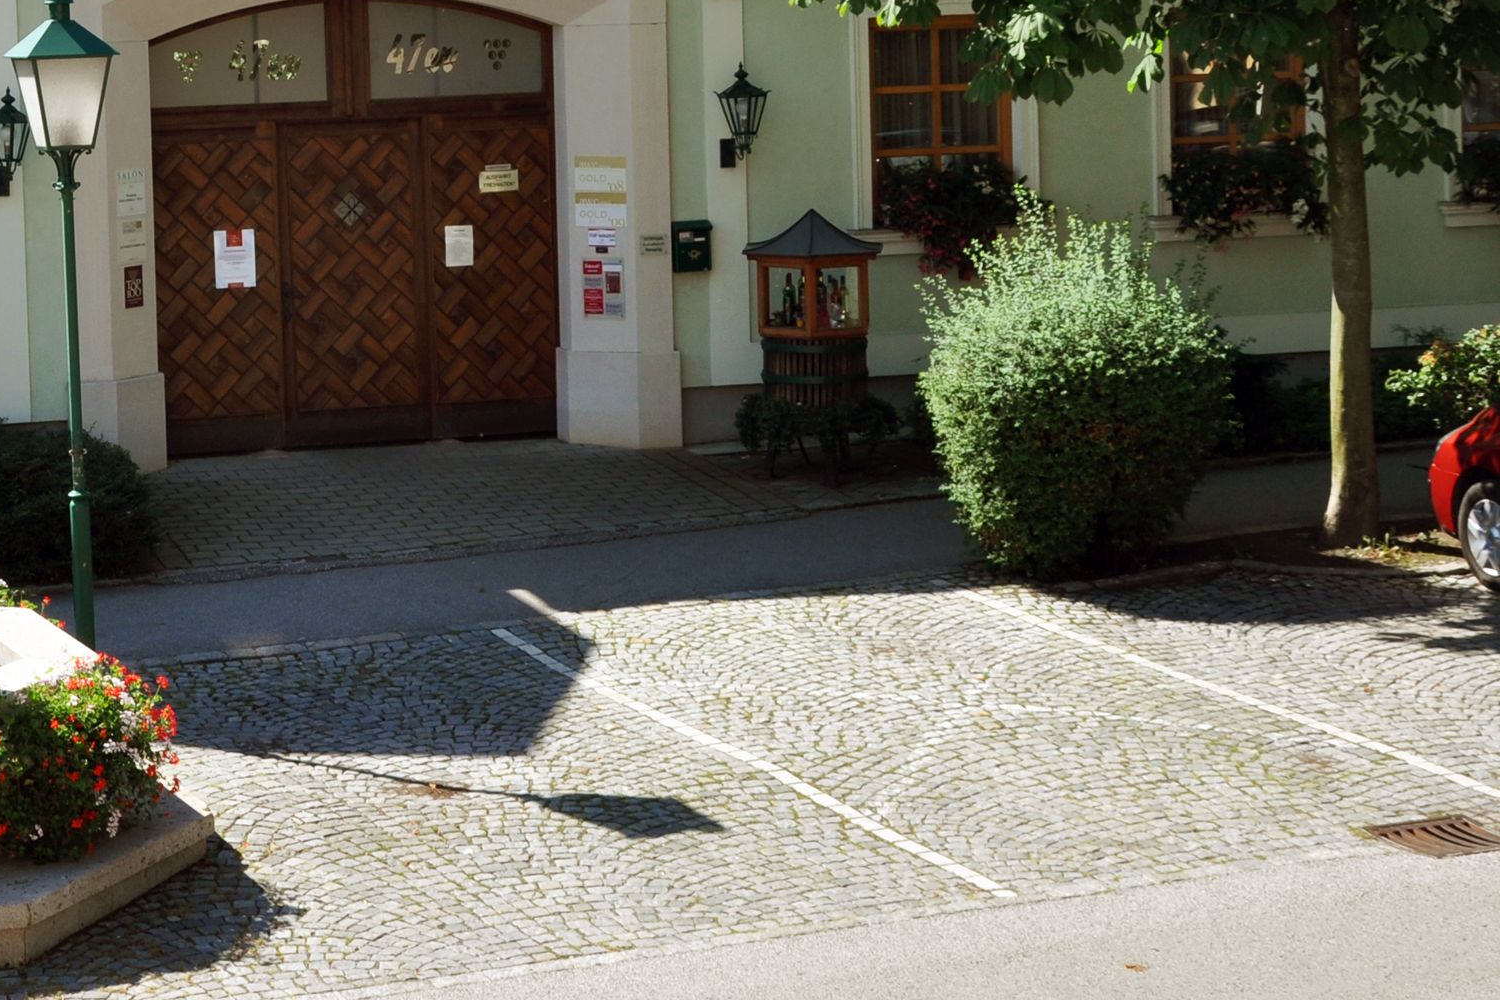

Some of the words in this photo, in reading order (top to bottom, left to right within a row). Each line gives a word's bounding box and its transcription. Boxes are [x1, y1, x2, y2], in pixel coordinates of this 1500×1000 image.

[579, 174, 607, 183] GOLD
[579, 209, 608, 219] GOLD
[126, 279, 142, 290] TOP
[126, 287, 142, 299] 100
